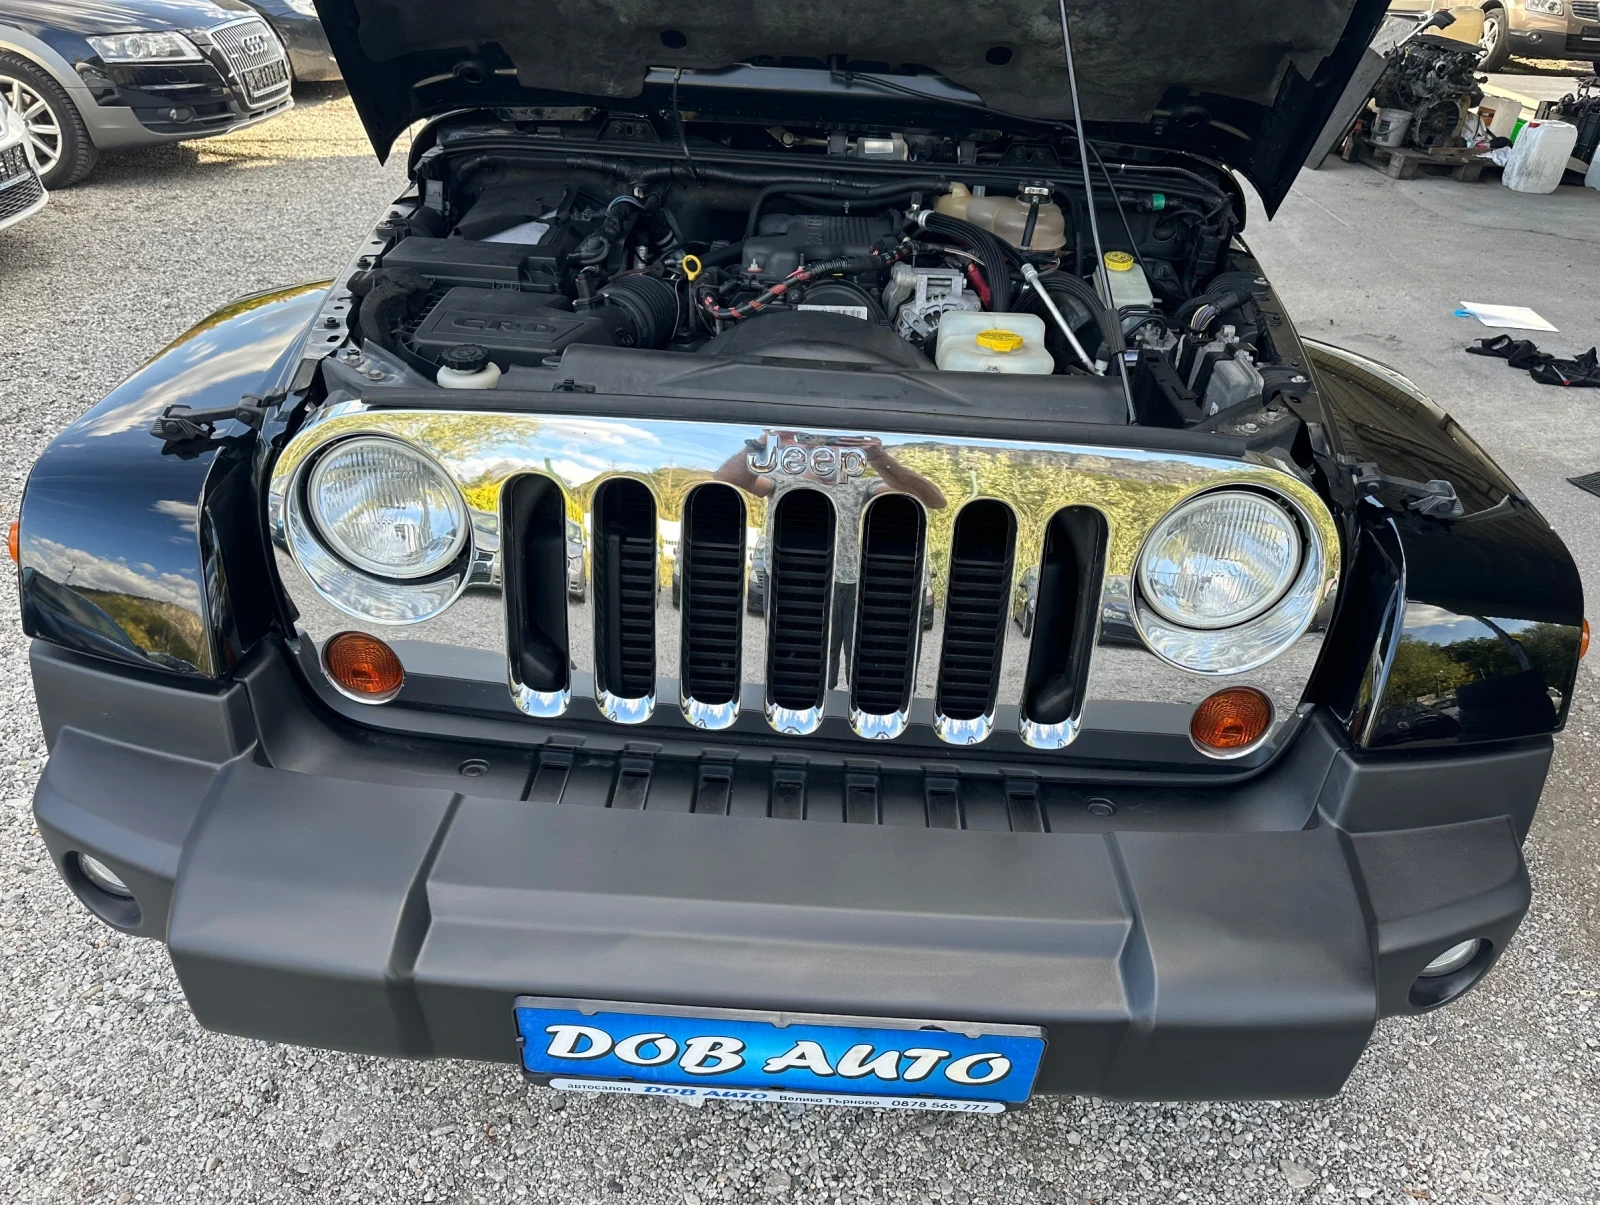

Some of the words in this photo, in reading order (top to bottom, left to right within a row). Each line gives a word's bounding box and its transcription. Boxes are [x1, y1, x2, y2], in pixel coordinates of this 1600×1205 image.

[451, 318, 557, 333] CRD
[746, 434, 868, 484] Jeep
[545, 1024, 747, 1076] DOB
[762, 1039, 1013, 1086] AUTO
[567, 1083, 631, 1092] автосалон
[643, 1086, 697, 1096] DOB
[703, 1090, 768, 1099] AUTO
[779, 1095, 823, 1103] Велико
[826, 1097, 880, 1106] Търново
[891, 1100, 927, 1108] 0878
[963, 1103, 989, 1111] 777
